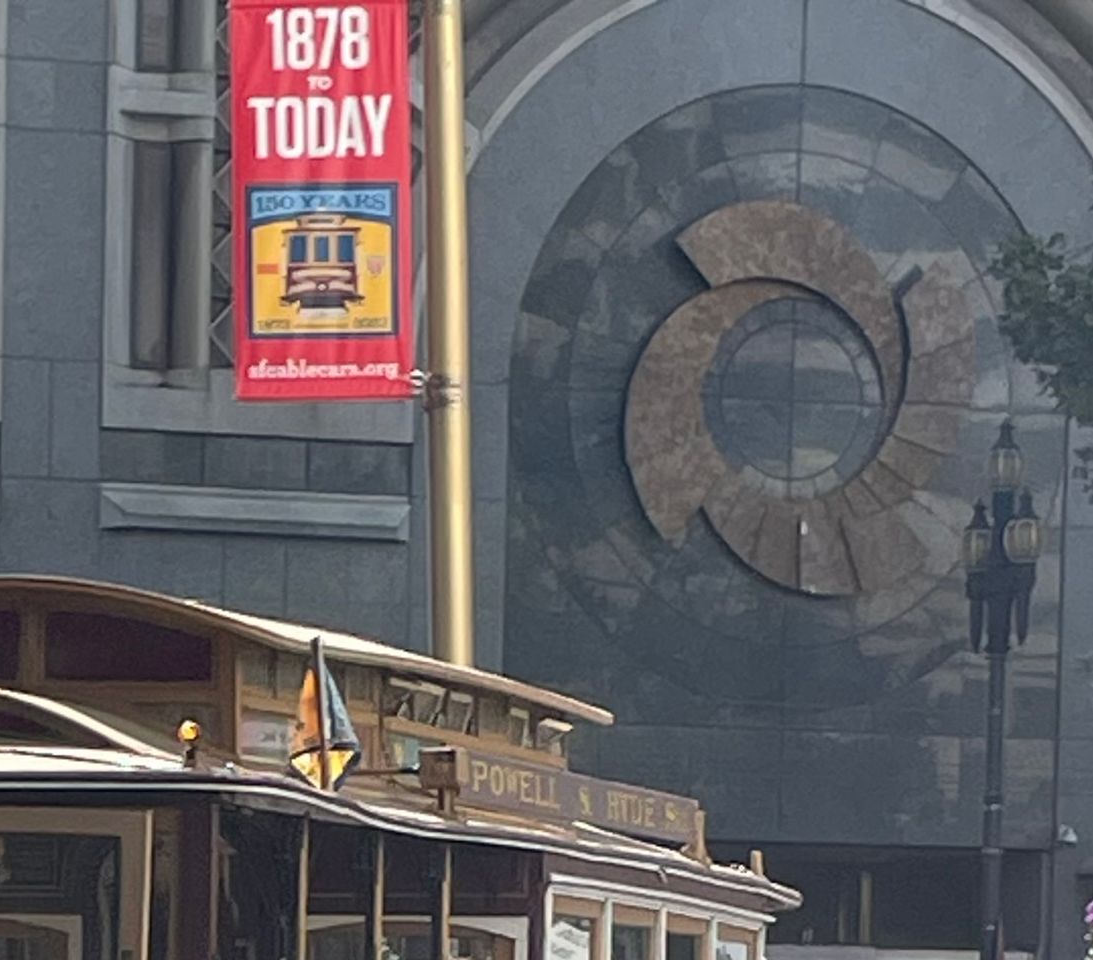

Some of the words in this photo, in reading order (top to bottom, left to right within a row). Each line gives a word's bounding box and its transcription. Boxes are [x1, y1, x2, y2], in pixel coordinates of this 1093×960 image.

[266, 6, 371, 71] 1878
[307, 75, 333, 91] TO
[246, 94, 393, 159] TODAY
[255, 195, 294, 213] 150
[299, 194, 386, 210] YEARS
[248, 358, 399, 380] sfcablecars.org
[471, 759, 560, 808] POWELL
